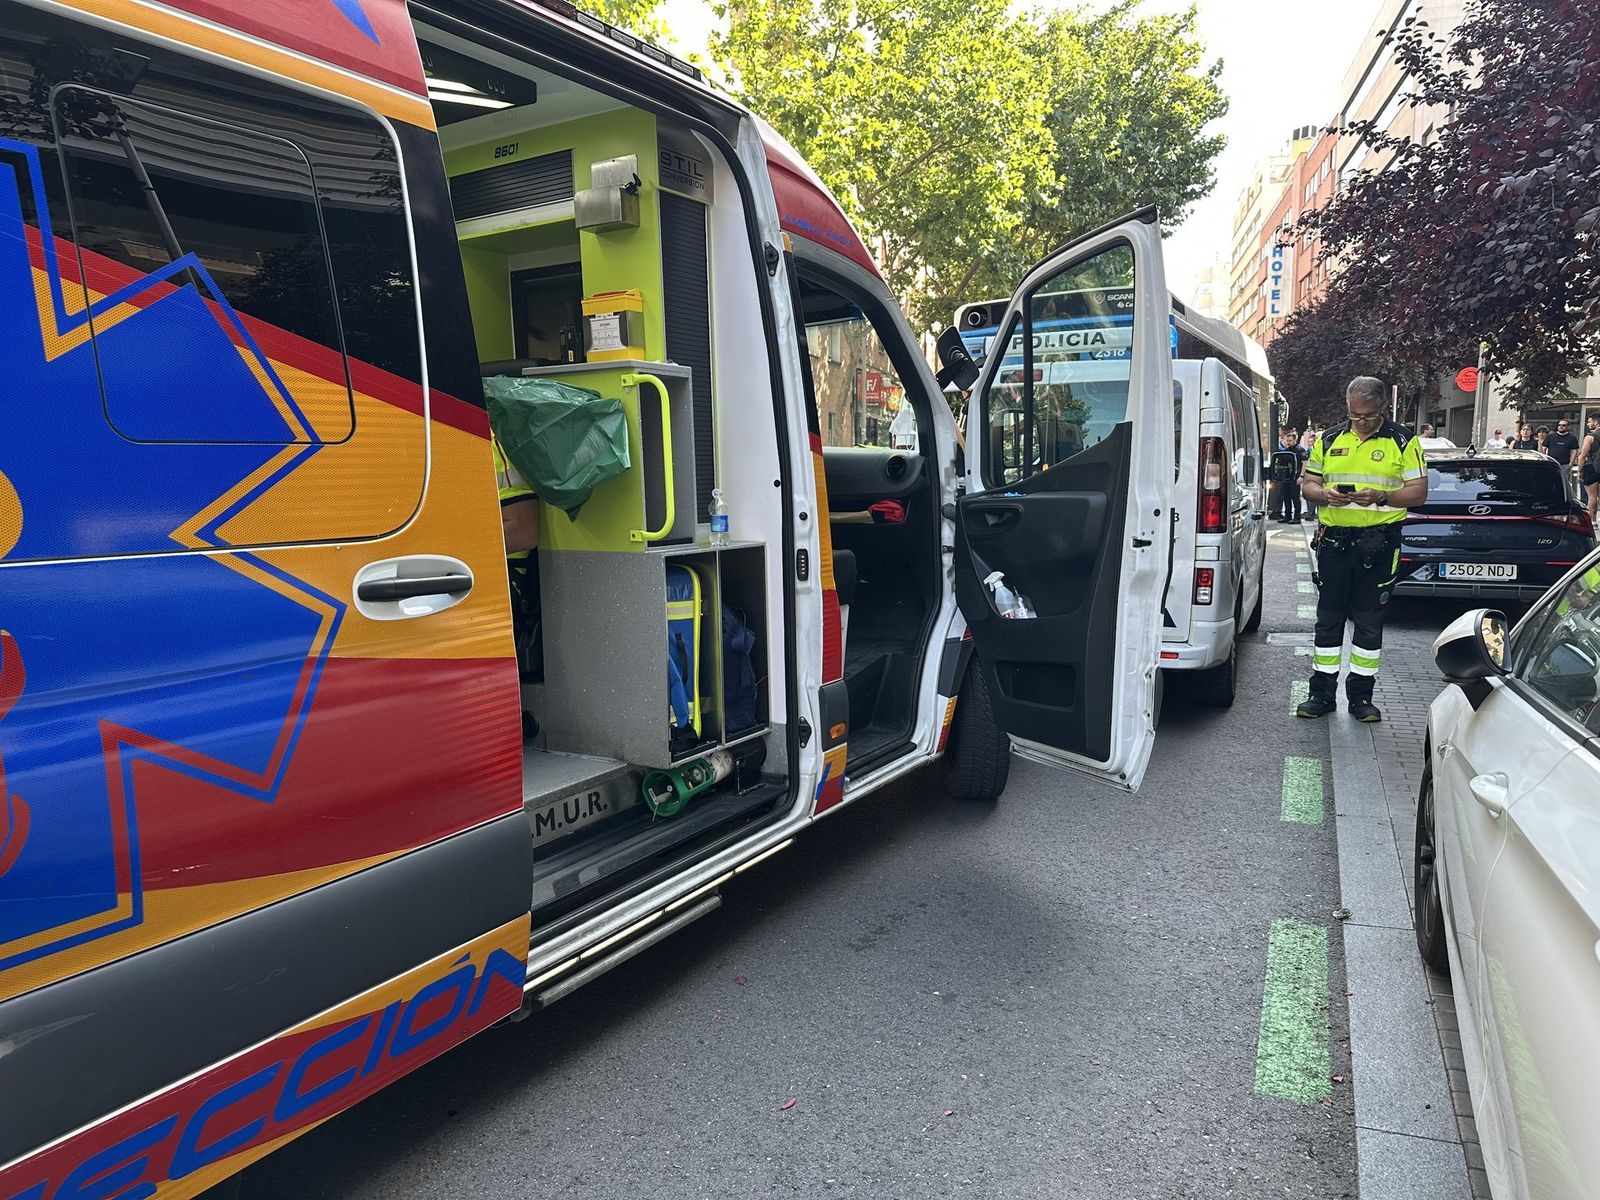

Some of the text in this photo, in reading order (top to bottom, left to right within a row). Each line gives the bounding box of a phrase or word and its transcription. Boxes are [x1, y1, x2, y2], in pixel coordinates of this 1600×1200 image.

[660, 151, 704, 178] STIL
[1270, 246, 1284, 315] HOTEL
[1107, 293, 1134, 301] SCANI
[1011, 331, 1106, 350] POLICIA
[1449, 564, 1515, 578] 2502 NDJ
